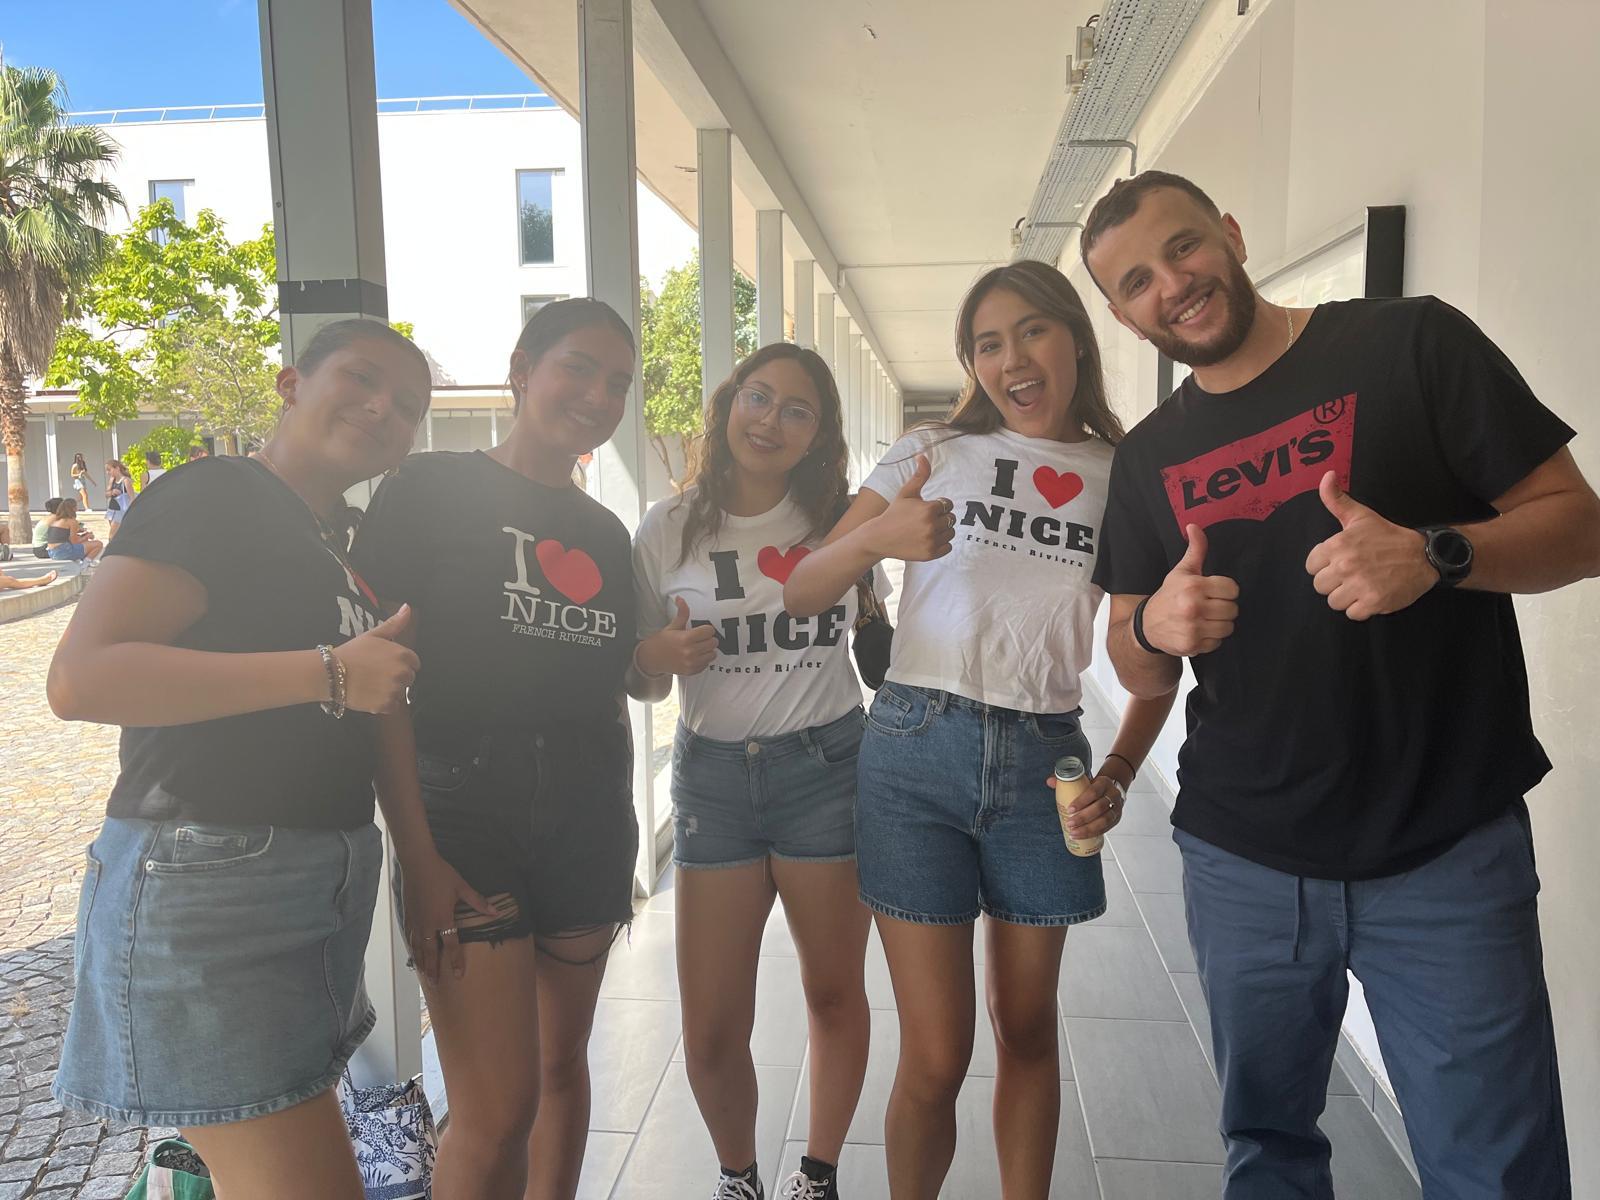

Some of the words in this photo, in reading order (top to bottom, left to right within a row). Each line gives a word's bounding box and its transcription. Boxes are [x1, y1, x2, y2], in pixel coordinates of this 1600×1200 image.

[991, 458, 1019, 500] I
[960, 500, 1095, 555] NICE
[966, 534, 1017, 552] French
[1029, 549, 1084, 568] Riviera
[502, 526, 540, 595] I
[708, 550, 745, 601] I
[336, 595, 385, 637] NI
[500, 591, 616, 638] NICE
[512, 623, 557, 640] FRENCH
[559, 631, 602, 647] RIVIERA
[691, 604, 846, 656] NICE
